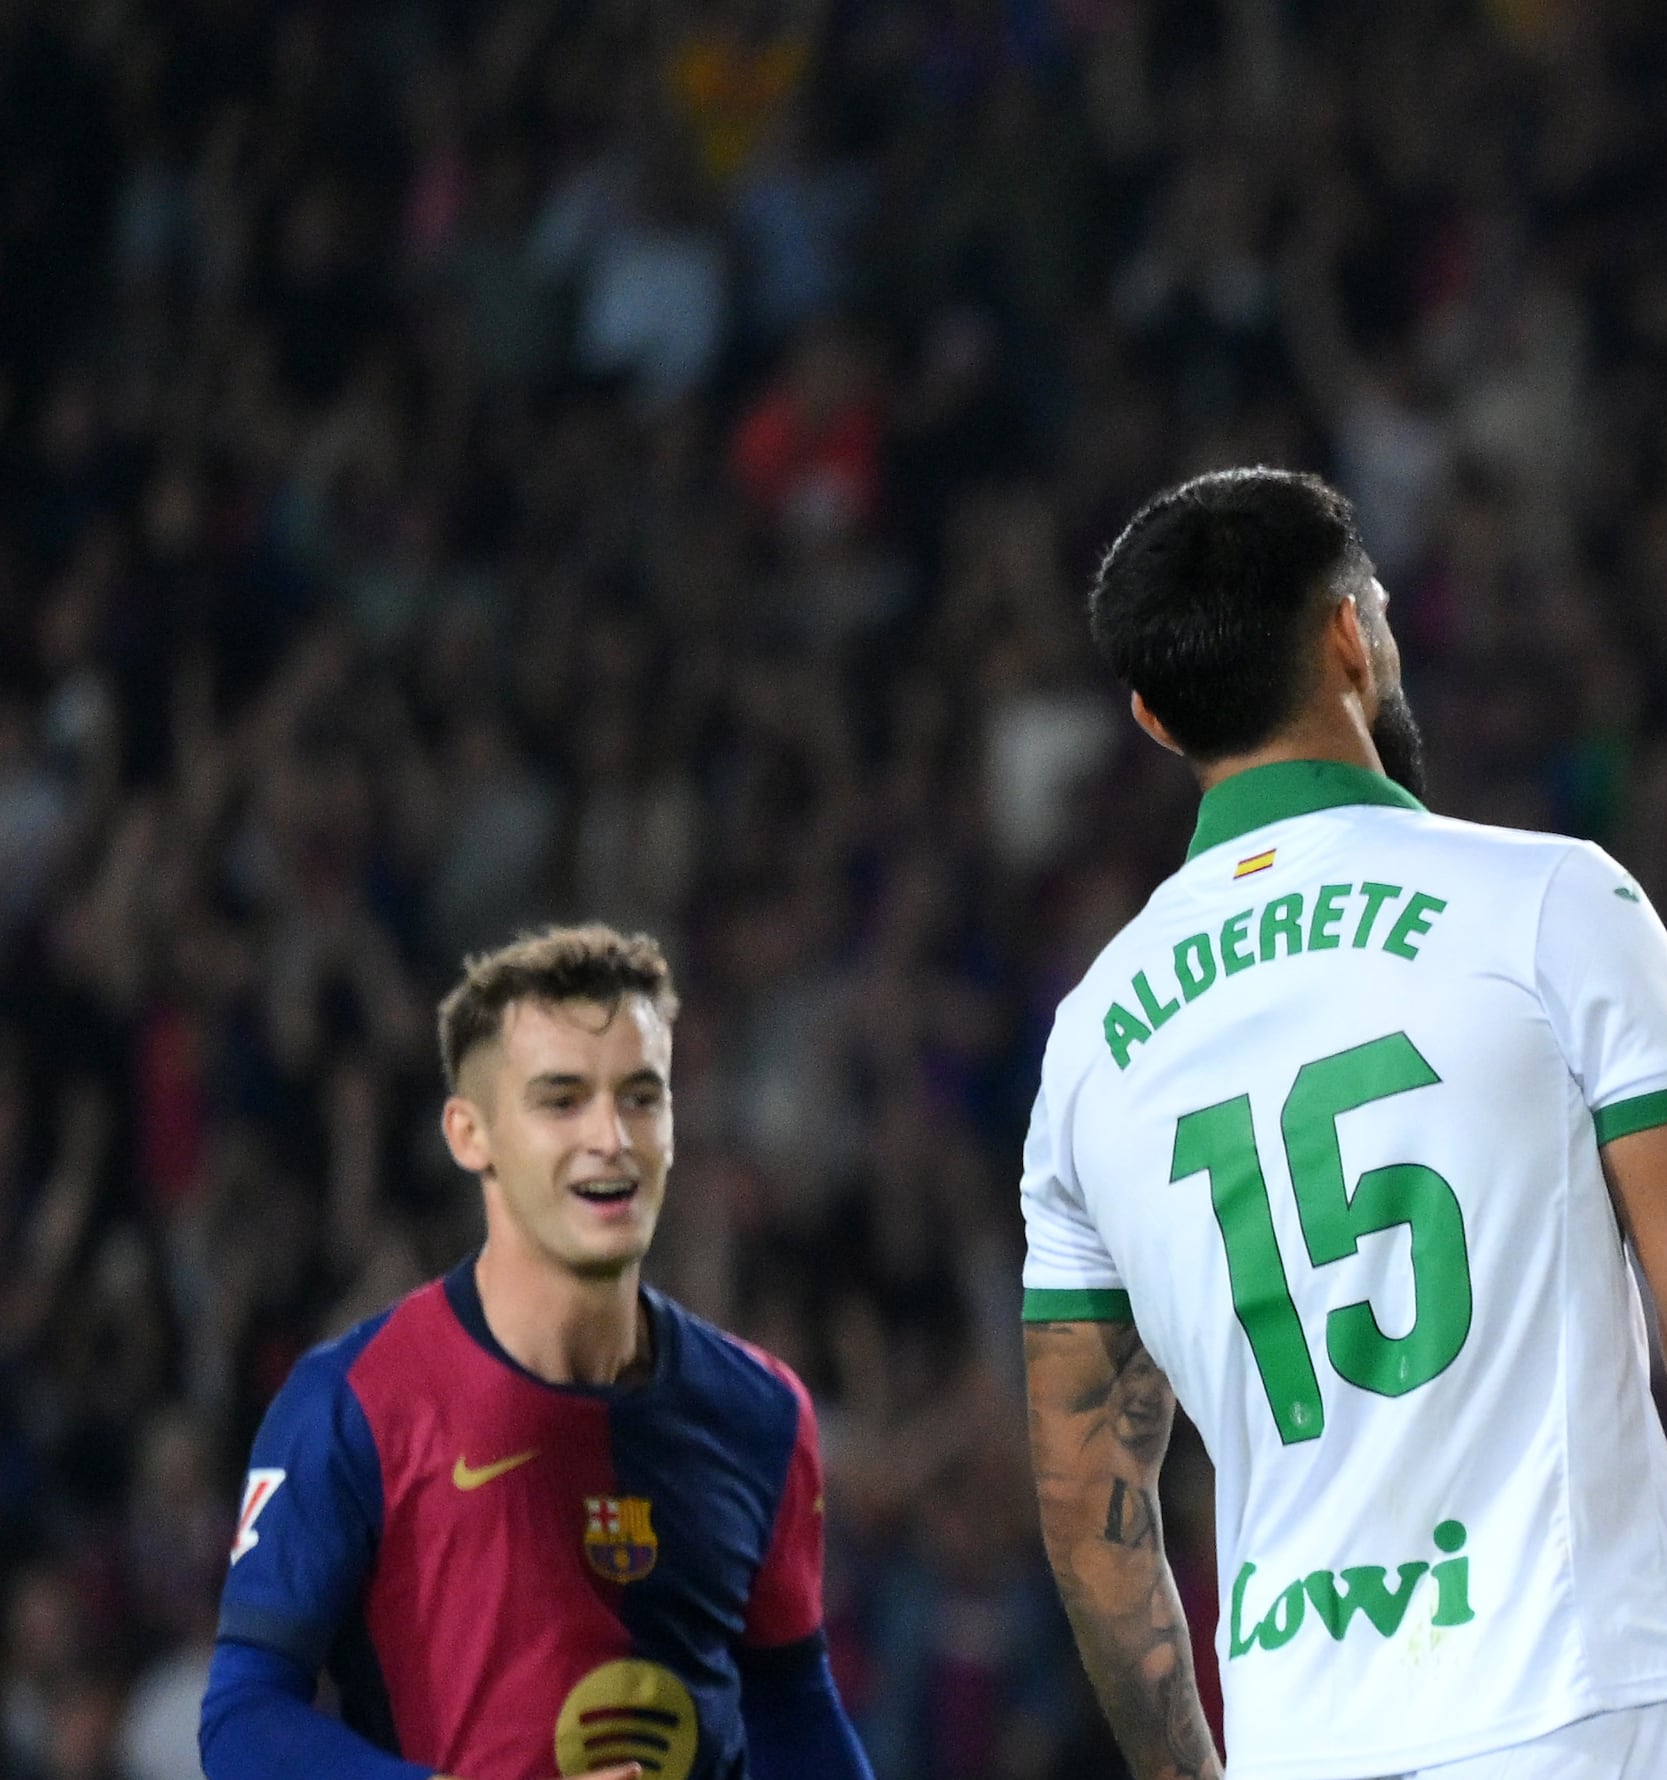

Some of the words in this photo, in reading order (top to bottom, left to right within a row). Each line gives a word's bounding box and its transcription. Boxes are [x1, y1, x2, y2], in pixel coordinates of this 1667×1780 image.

[1102, 880, 1449, 1071] ALDERETE
[1169, 1030, 1473, 1446] 15
[1228, 1518, 1477, 1661] Lowi
